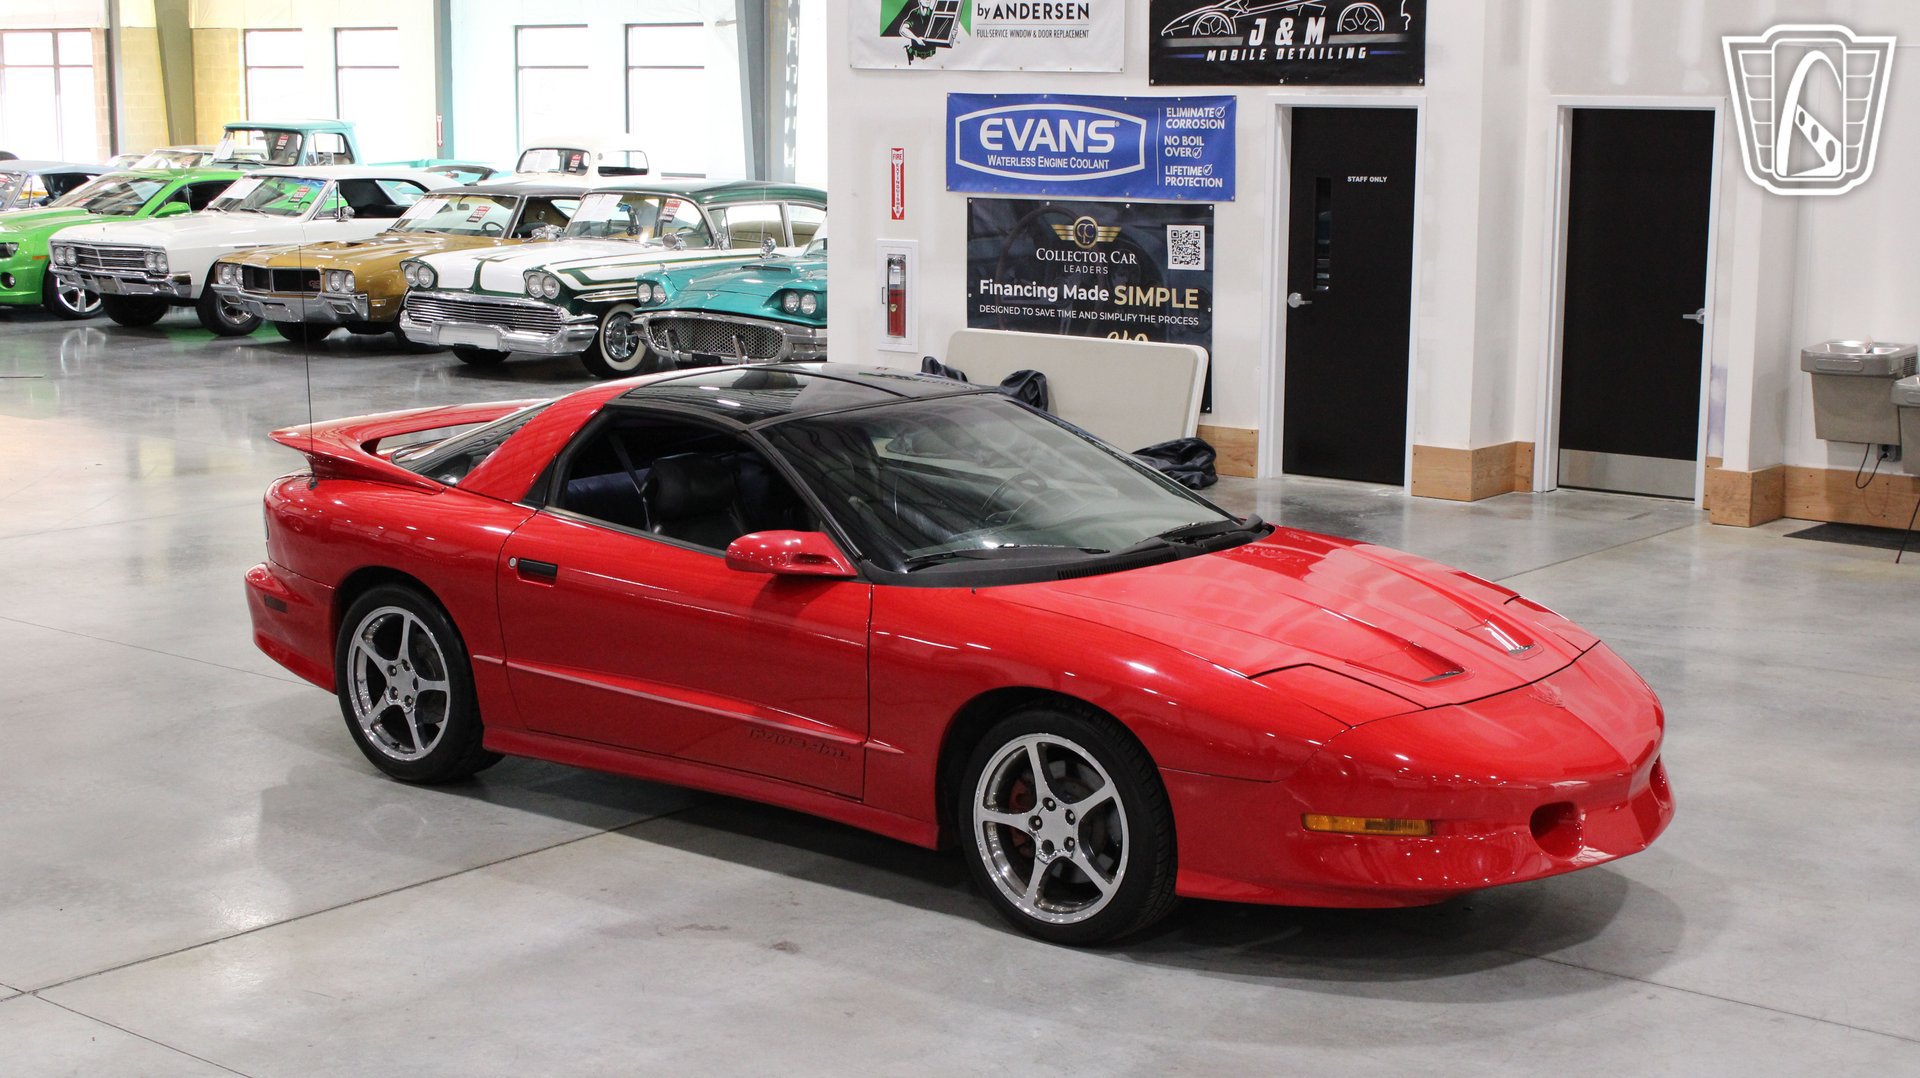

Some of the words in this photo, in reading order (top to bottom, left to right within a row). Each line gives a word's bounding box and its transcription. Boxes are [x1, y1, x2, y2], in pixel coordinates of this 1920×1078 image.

[977, 4, 991, 20] by
[993, 3, 1090, 20] ANDERSEN
[1010, 29, 1031, 38] WINDOW
[1033, 30, 1037, 38] &
[1038, 29, 1052, 38] DOOR
[1054, 29, 1089, 39] REPLACEMENT
[1249, 18, 1267, 46] J
[1275, 17, 1295, 45] &
[1304, 17, 1326, 45] M
[1206, 49, 1267, 62] MOBILE
[1276, 47, 1367, 61] DETAILING
[1166, 107, 1215, 118] ELIMINATE
[1165, 119, 1225, 129] CORROSION
[979, 118, 1115, 154] EVANS
[1164, 135, 1180, 146] NO
[1181, 135, 1205, 146] BOIL
[1164, 147, 1193, 158] OVER
[987, 155, 1036, 168] WATERLESS
[1038, 156, 1068, 168] ENGINE
[1070, 157, 1110, 169] COOLANT
[1165, 165, 1203, 176] LIFETIME
[1165, 176, 1223, 188] PROTECTION
[1036, 248, 1108, 264] COLLECTOR
[1110, 250, 1138, 265] CAR
[1063, 265, 1109, 275] LEADERS
[979, 279, 1058, 302] Financing
[1063, 284, 1110, 301] Made
[1114, 285, 1199, 309] SIMPLE
[979, 304, 1021, 315] DESIGNED
[1022, 307, 1034, 316] TO
[1035, 308, 1056, 317] SAVE
[1057, 309, 1077, 319] TIME
[1078, 311, 1098, 320] AND
[1099, 311, 1138, 323] SIMPLIFY
[1139, 314, 1156, 323] THE
[1158, 315, 1199, 326] PROCESS
